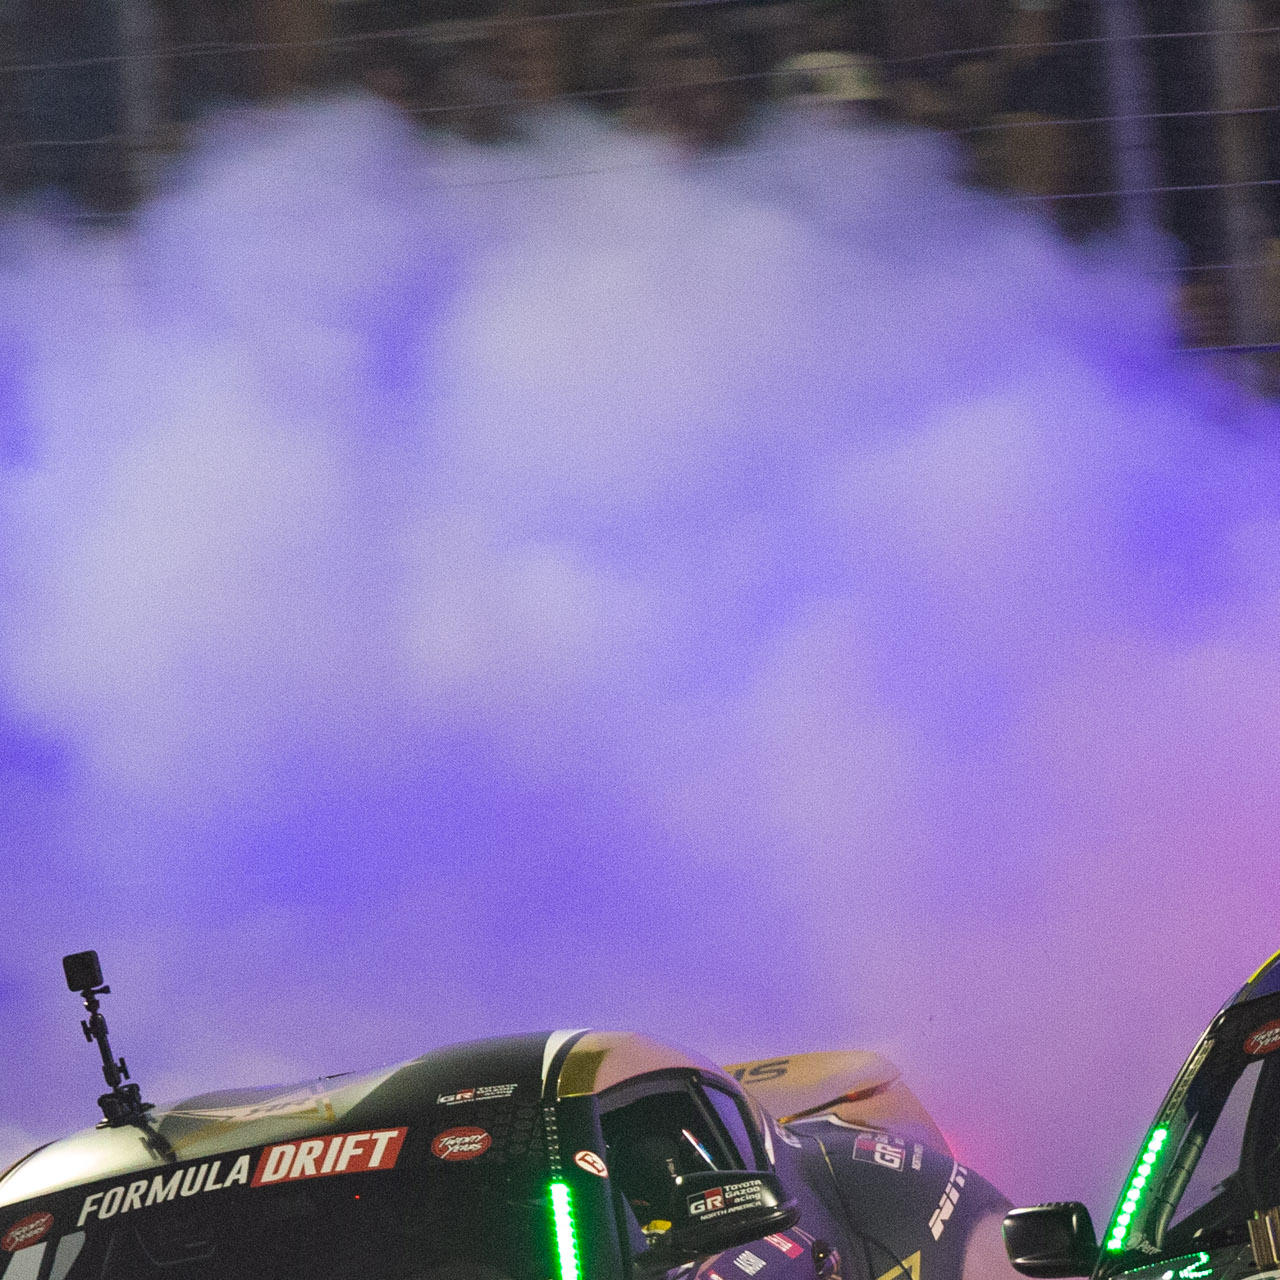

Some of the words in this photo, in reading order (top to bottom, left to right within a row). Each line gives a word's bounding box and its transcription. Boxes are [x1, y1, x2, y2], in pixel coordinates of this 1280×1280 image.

[76, 1153, 249, 1227] FORMULA
[260, 1130, 401, 1182] DRIFT
[723, 1180, 762, 1191] TOYOTA
[725, 1187, 761, 1199] GAZOO
[690, 1195, 724, 1215] GR
[700, 1209, 727, 1220] NORTH
